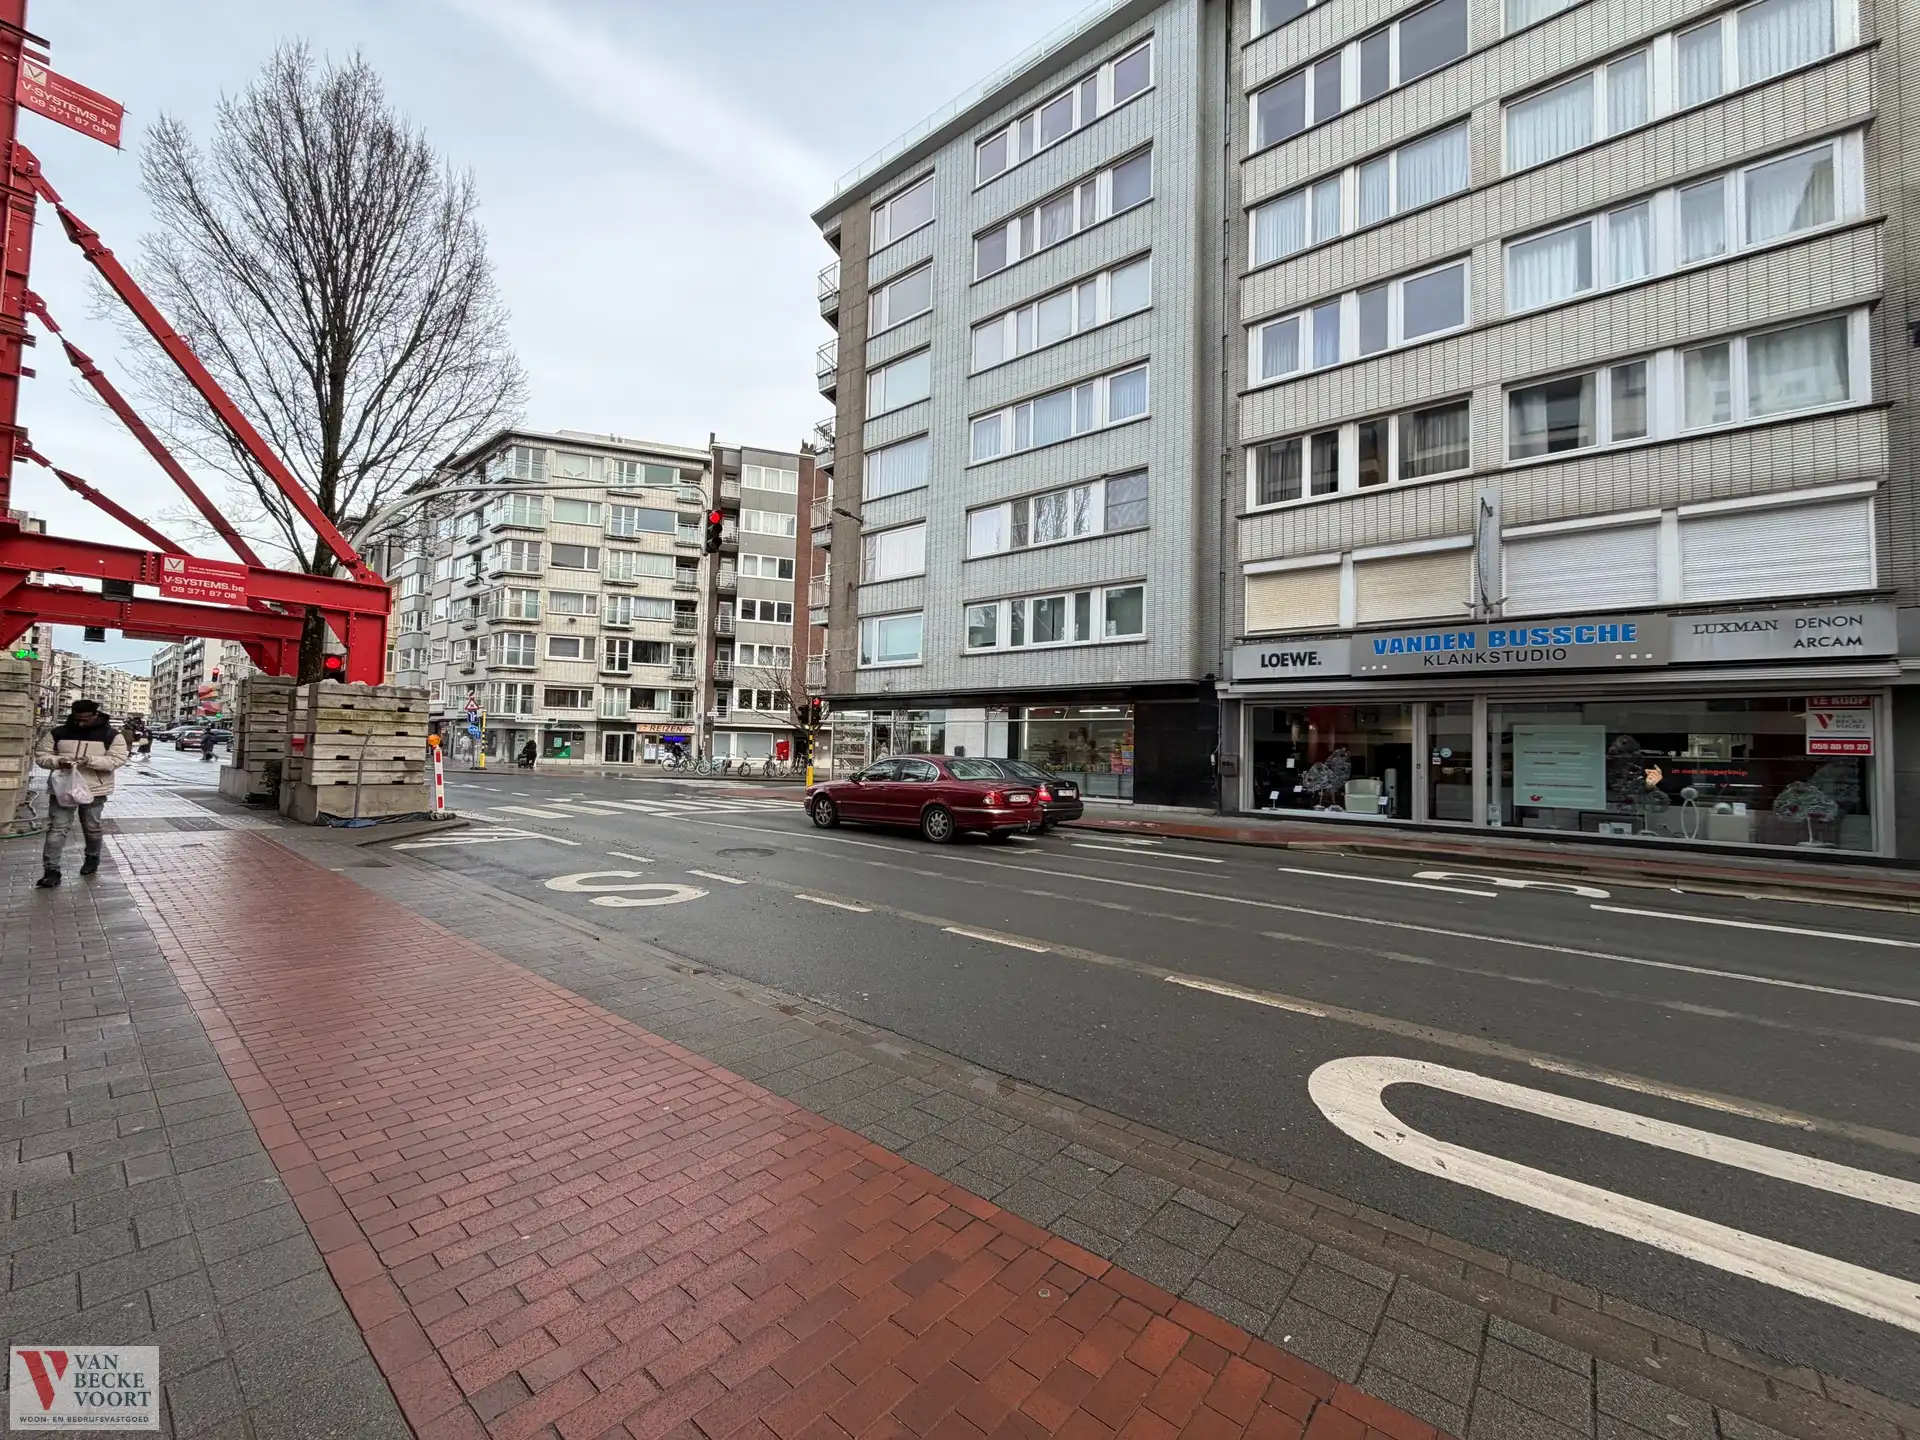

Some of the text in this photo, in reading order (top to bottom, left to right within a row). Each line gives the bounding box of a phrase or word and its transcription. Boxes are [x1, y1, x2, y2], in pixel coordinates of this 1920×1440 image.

[22, 80, 116, 131] V-SYSTEMS.be
[30, 95, 46, 107] 09
[49, 105, 70, 119] 371
[163, 575, 244, 592] V-SYSTEMS.be
[171, 585, 185, 593] 09
[187, 588, 206, 596] 371
[1692, 619, 1779, 635] LUXMAN
[1795, 615, 1863, 629] DENON
[1373, 623, 1638, 656] VANDEN BUSSCHE
[1793, 636, 1863, 649] ARCAM
[1424, 648, 1567, 667] KLANKSTUDIO
[1813, 695, 1867, 705] TE KOOP
